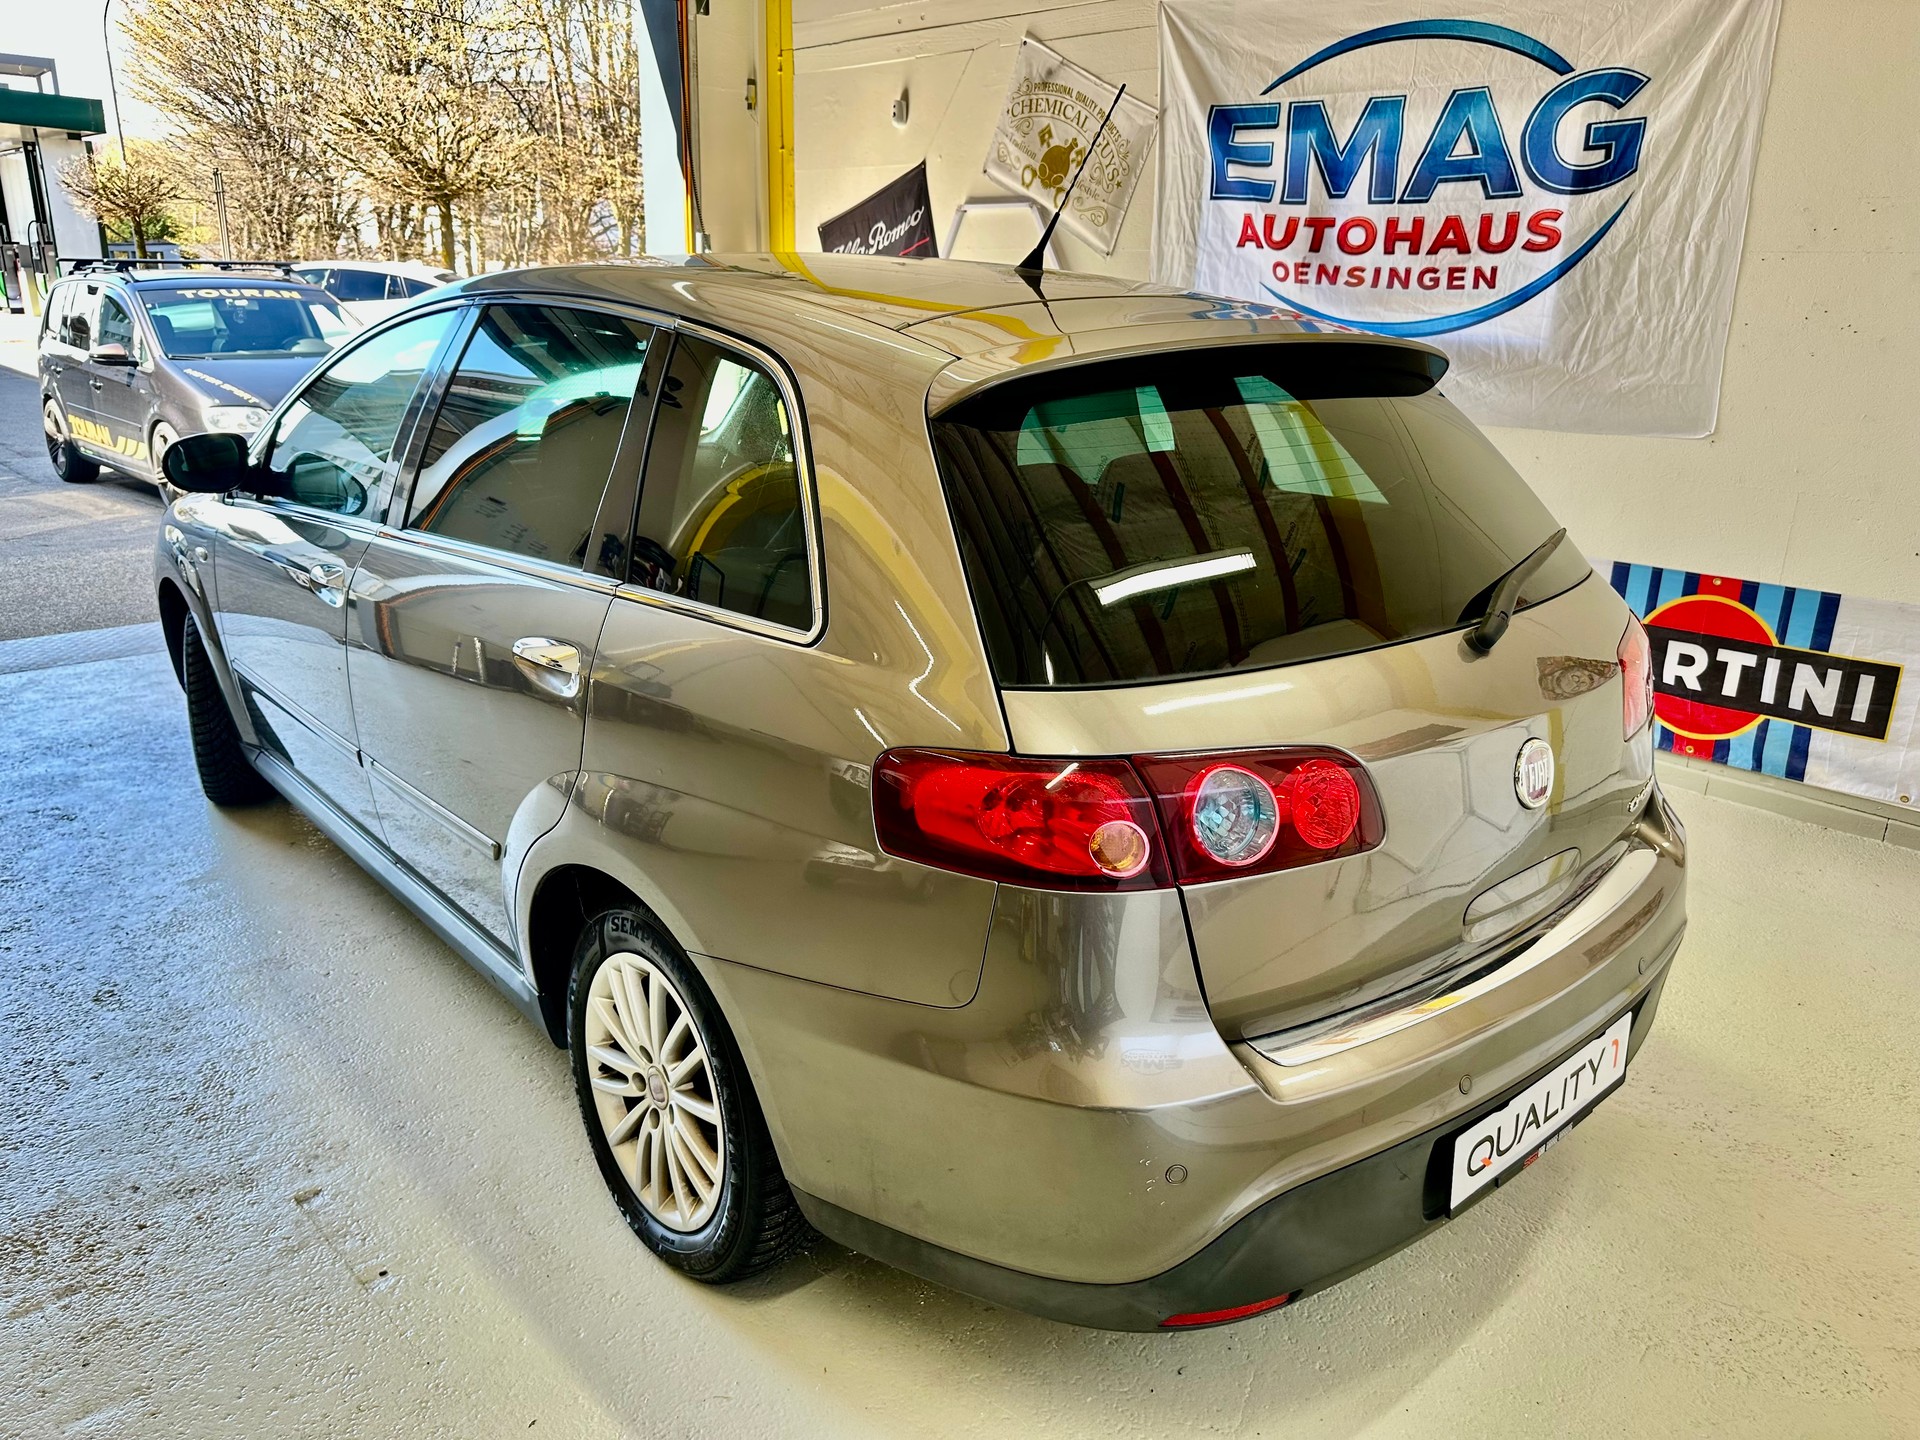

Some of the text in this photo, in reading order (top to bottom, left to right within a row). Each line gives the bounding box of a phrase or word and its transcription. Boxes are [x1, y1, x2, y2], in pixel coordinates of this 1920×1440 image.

[1033, 81, 1122, 142] PROFESSIONAL QUALITY PRDUCTS
[1011, 98, 1120, 182] CHEMICAL GUYS
[1208, 67, 1652, 205] EMAG
[1070, 178, 1100, 201] ifestyle
[868, 205, 925, 254] Romeo
[1236, 208, 1564, 256] AUTOHAUS
[176, 289, 303, 299] TOURAN
[1272, 260, 1499, 290] OENSINGEN
[67, 413, 115, 448] TOURAN
[1652, 639, 1876, 724] RTINI
[1527, 757, 1549, 794] FIAT
[1466, 1046, 1606, 1178] QUALITY
